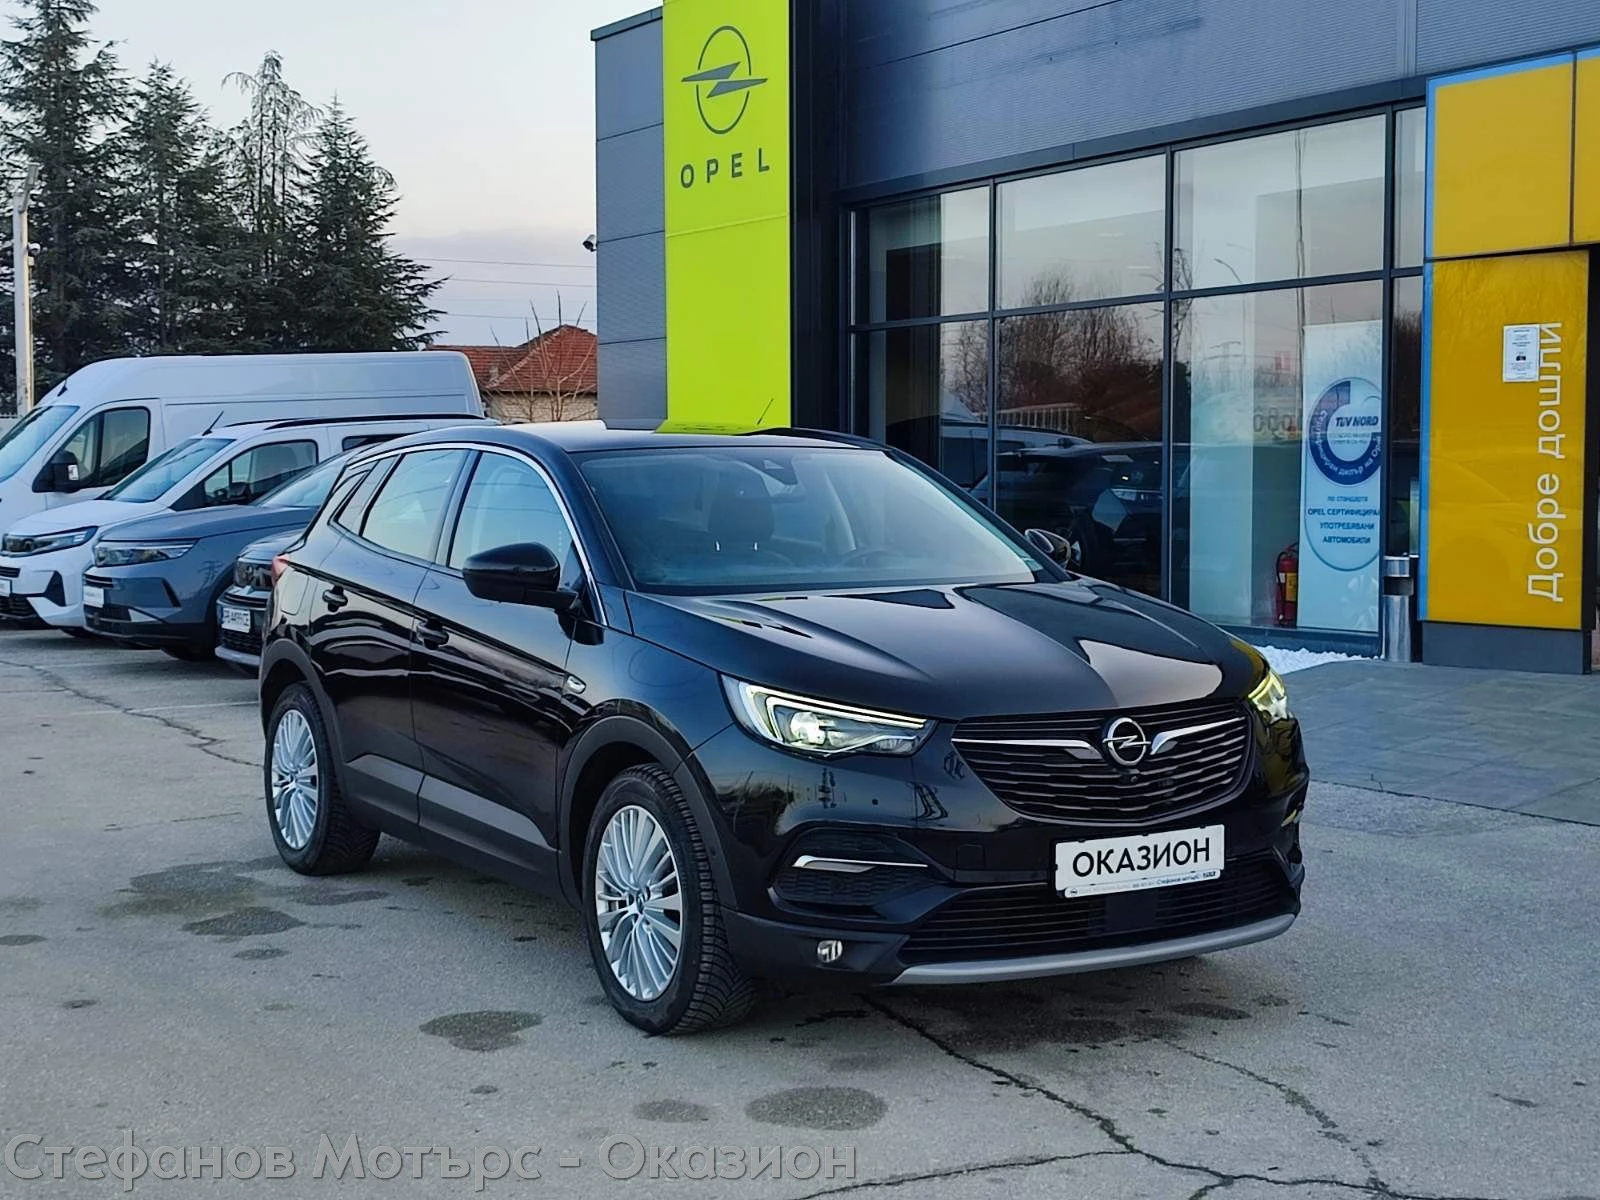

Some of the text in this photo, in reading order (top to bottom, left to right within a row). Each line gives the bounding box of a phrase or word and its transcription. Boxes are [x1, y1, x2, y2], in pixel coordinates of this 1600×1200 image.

[680, 147, 770, 189] OPEL
[1353, 415, 1379, 427] NORD
[1527, 322, 1566, 602] Добре дошли
[1307, 508, 1380, 517] OPEL СЕРТИФИЦИРА
[1322, 536, 1371, 545] АВТОМОБИЛИ
[1072, 837, 1211, 878] ОКАЗИОН
